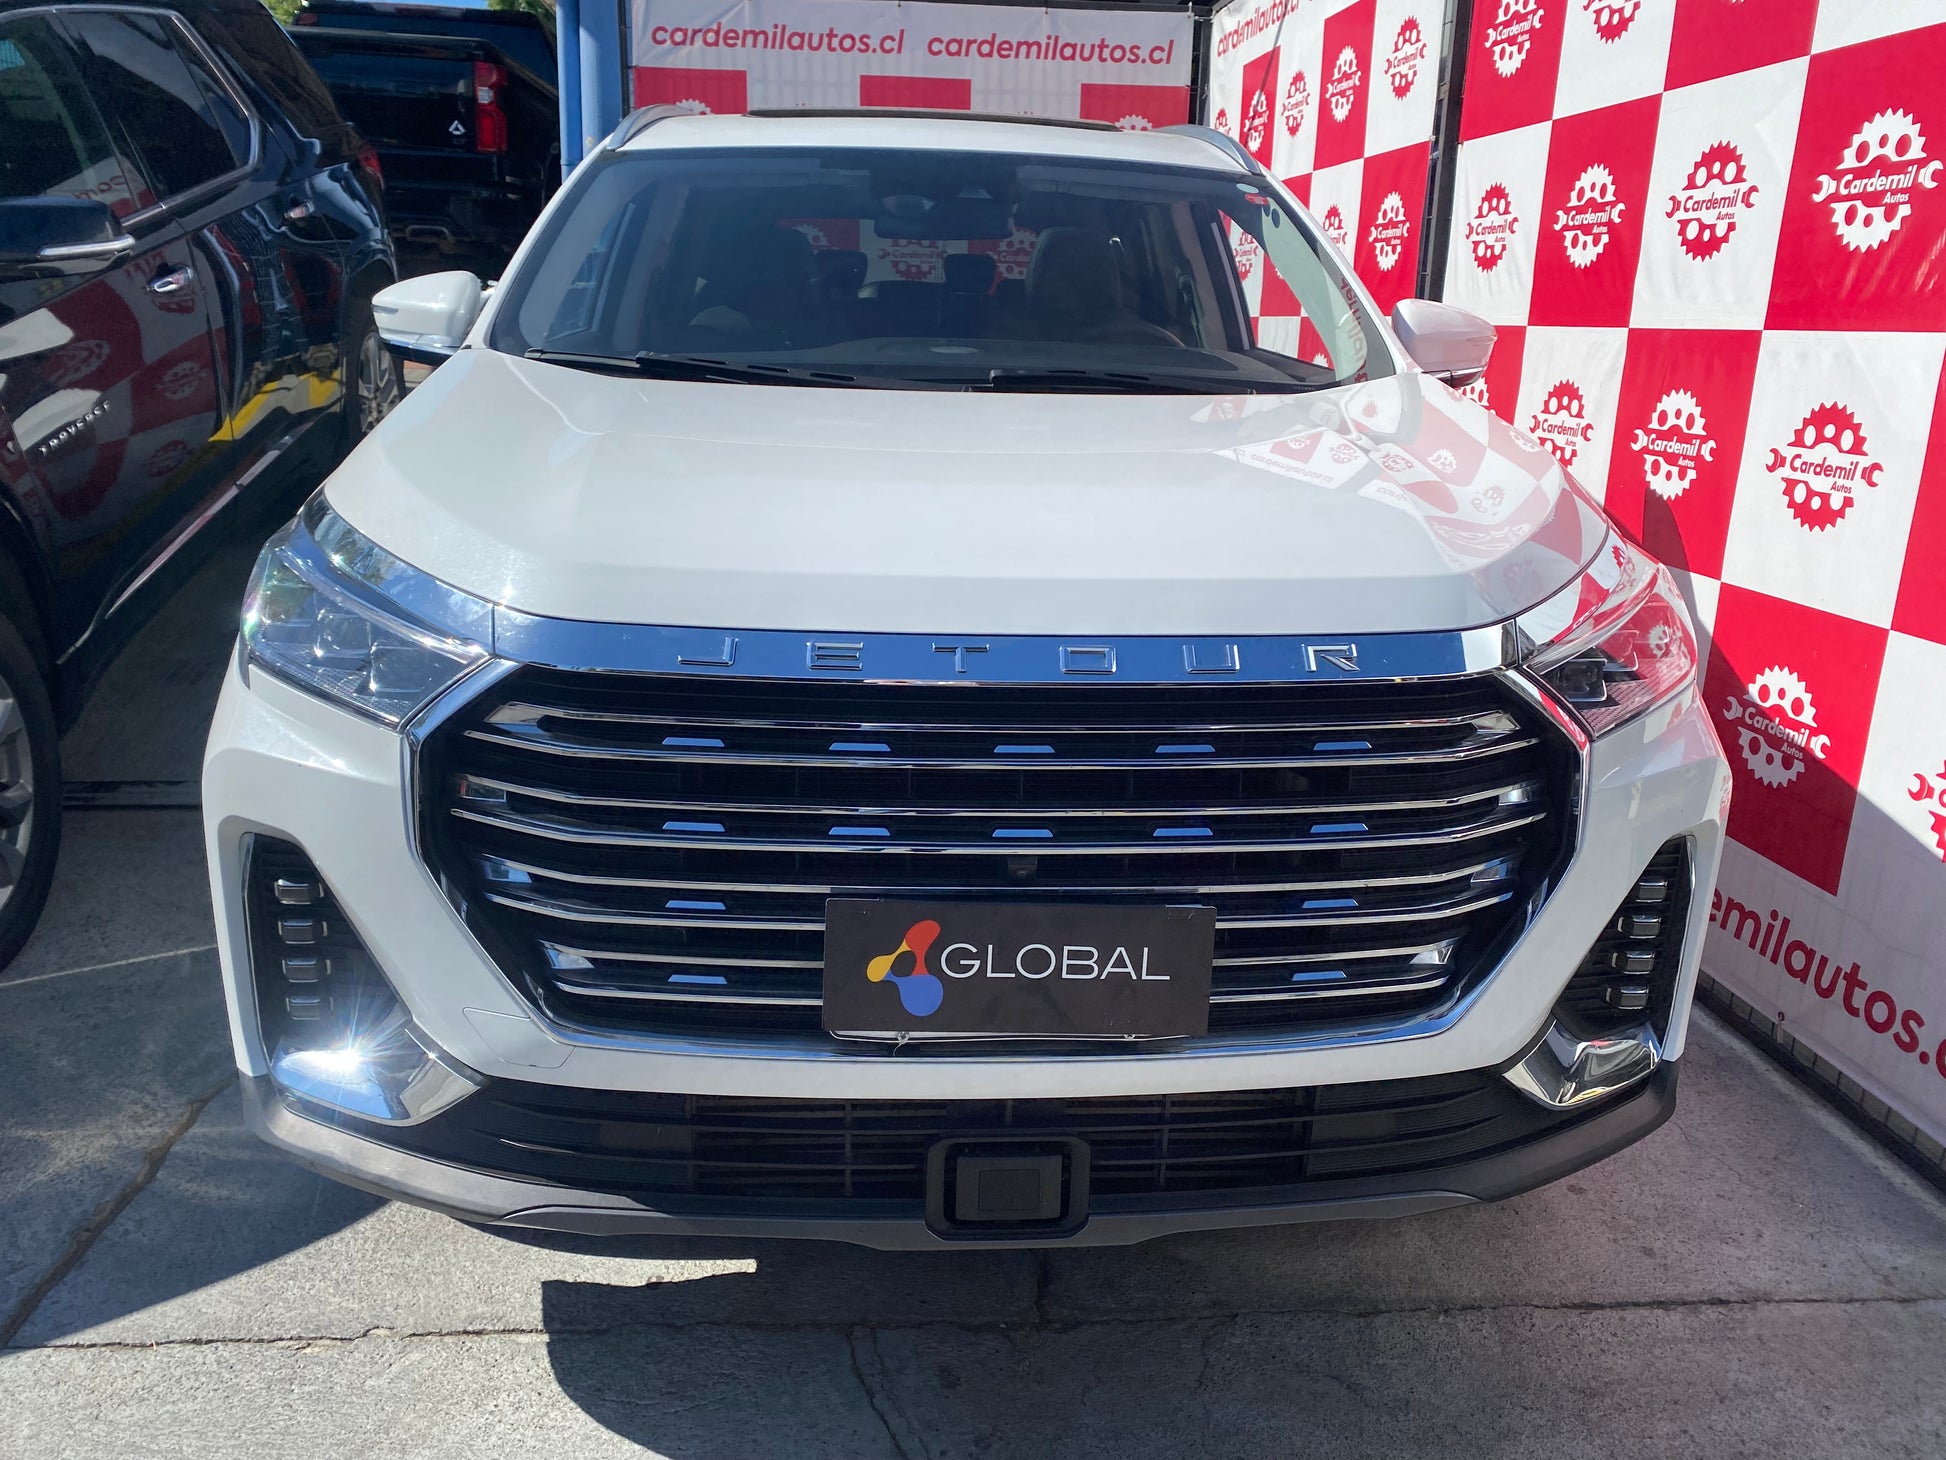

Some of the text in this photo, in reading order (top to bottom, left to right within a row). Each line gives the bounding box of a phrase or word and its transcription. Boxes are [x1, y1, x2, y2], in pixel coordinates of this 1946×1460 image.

[1497, 14, 1533, 40] Cardemil
[651, 22, 1175, 65] cardemilautos.cl cardemilautos.cl
[1838, 164, 1917, 195] Cardemil
[1682, 188, 1741, 213] Cardemil
[1882, 191, 1910, 203] Autos
[1567, 206, 1611, 226] Cardemil
[1715, 210, 1736, 221] Autos
[1475, 220, 1508, 236] Cardemil
[1541, 418, 1581, 438] Cardemil
[1648, 433, 1700, 457] Cardemil
[1677, 456, 1695, 468] Autos
[1789, 453, 1860, 481] Cardemil
[1830, 480, 1852, 494] Autos
[677, 636, 1361, 675] JETOUR
[1744, 706, 1810, 748] Cardemil
[1781, 742, 1804, 759] Autos
[940, 942, 1171, 981] GLOBAL
